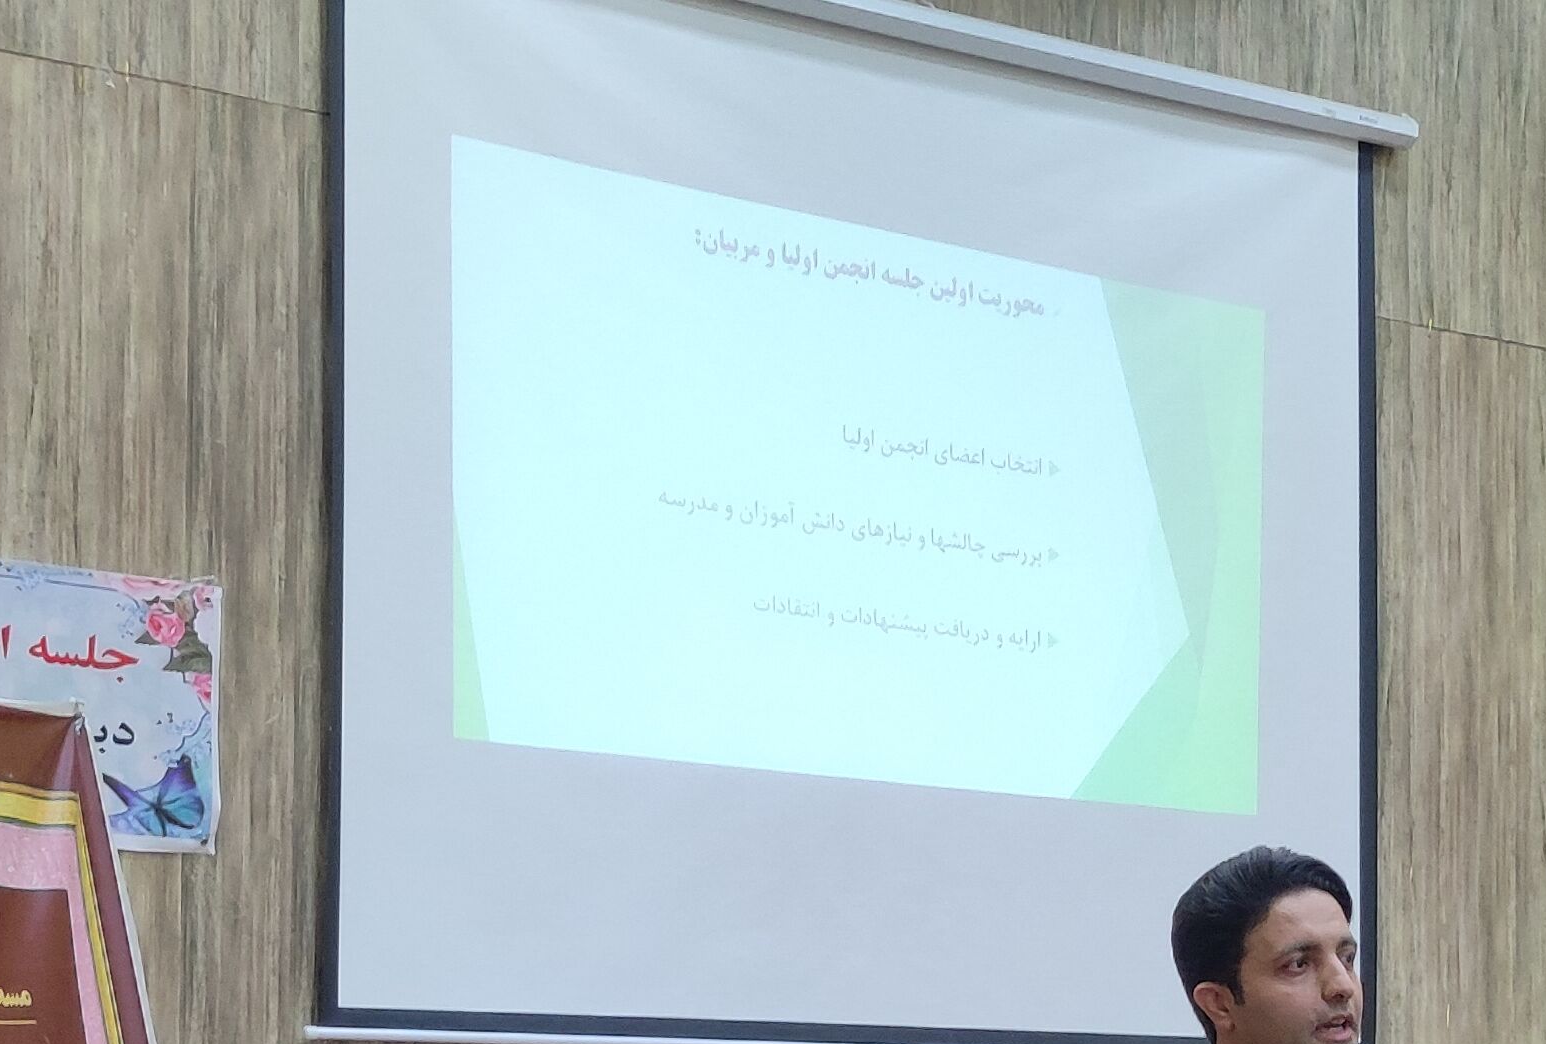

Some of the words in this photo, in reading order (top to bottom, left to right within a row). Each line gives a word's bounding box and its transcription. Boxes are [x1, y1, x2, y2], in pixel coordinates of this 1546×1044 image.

[766, 248, 776, 268] و
[782, 241, 818, 275] اولیا
[823, 260, 876, 285] انجمن
[881, 267, 924, 297] جلسه
[929, 276, 974, 307] اولین
[842, 424, 875, 451] اولیا
[881, 437, 929, 461] انجمن
[934, 443, 986, 467] اعضای
[990, 453, 1043, 476] انتخاب
[658, 490, 720, 515] مدرسه
[724, 503, 734, 522] و
[739, 500, 795, 529] آموزان
[802, 513, 846, 535] دانش
[851, 518, 913, 546] نیازهای
[918, 534, 927, 550] و
[991, 547, 1043, 569] بررسی
[752, 595, 820, 620] انتقادات
[934, 619, 990, 647] دریافت
[28, 634, 140, 684] جلسه
